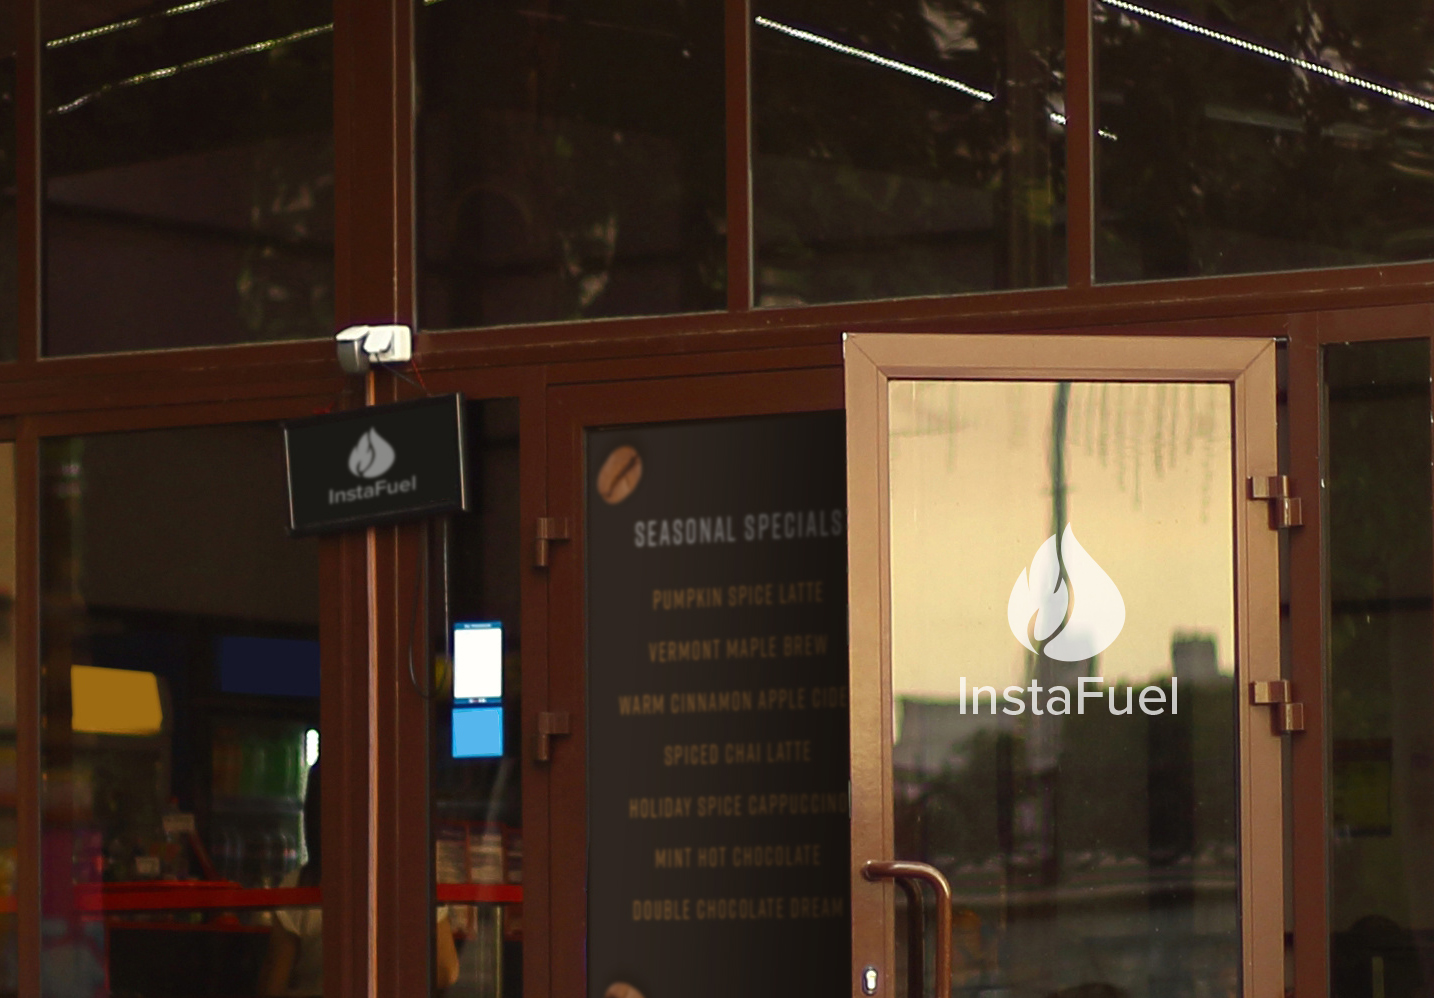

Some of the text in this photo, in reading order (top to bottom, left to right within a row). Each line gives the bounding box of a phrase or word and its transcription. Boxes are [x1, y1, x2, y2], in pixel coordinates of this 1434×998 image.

[328, 475, 417, 504] InstaFuel
[633, 510, 843, 549] SEASONAL SPECIALS
[652, 581, 823, 610] PUMPKIN SPICE LATTE
[648, 635, 828, 662] VERMONT MAPLE BREW
[618, 686, 848, 716] WARM CINNAMON APPLE CIDE
[959, 676, 1178, 716] InstaFuel
[663, 740, 811, 766] SPICED CHAI LATTE
[629, 797, 692, 819] HOLIDAY
[697, 795, 742, 817] SPICE
[655, 844, 821, 869] MINT HOT CHOCOLATE
[632, 897, 844, 922] DOUBLE CHOCOLATE DREAM
